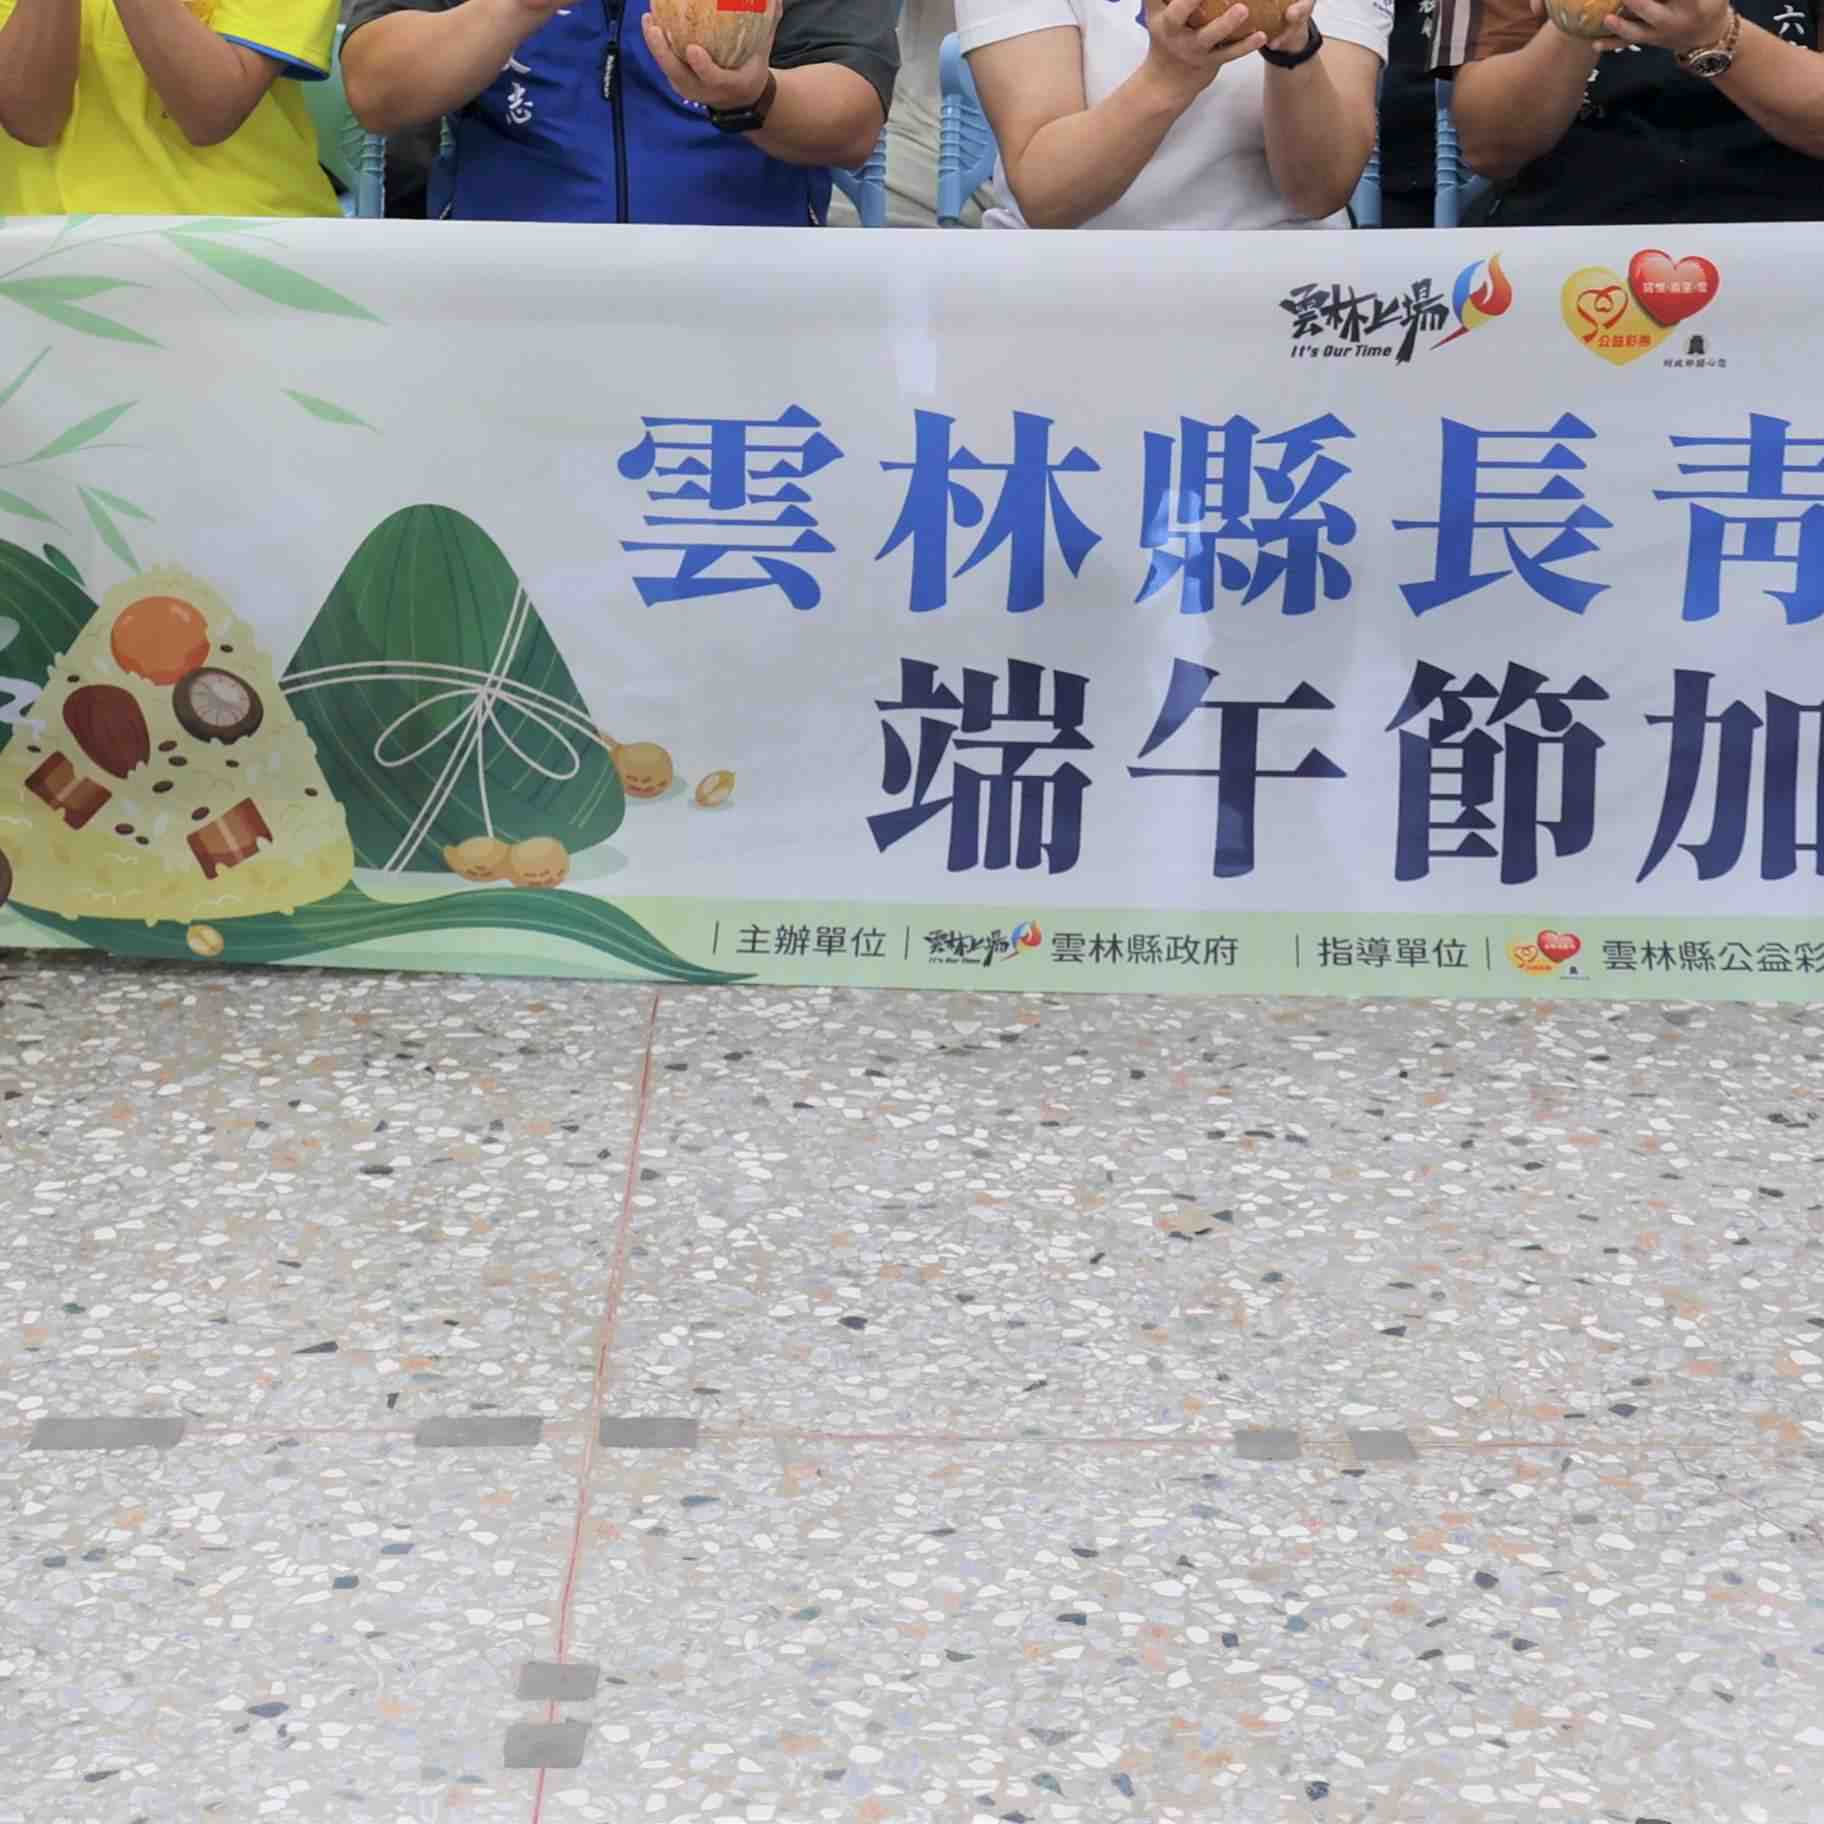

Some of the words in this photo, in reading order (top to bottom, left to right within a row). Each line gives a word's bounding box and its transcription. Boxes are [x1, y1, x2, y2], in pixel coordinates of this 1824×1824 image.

[1279, 277, 1449, 366] 雲林上場
[1291, 344, 1319, 359] It's
[1323, 344, 1353, 359] Our
[1355, 343, 1392, 358] Time
[739, 924, 886, 958] 主辦單位
[1051, 932, 1239, 966] 雲林縣政府
[1318, 936, 1467, 969] 指導單位
